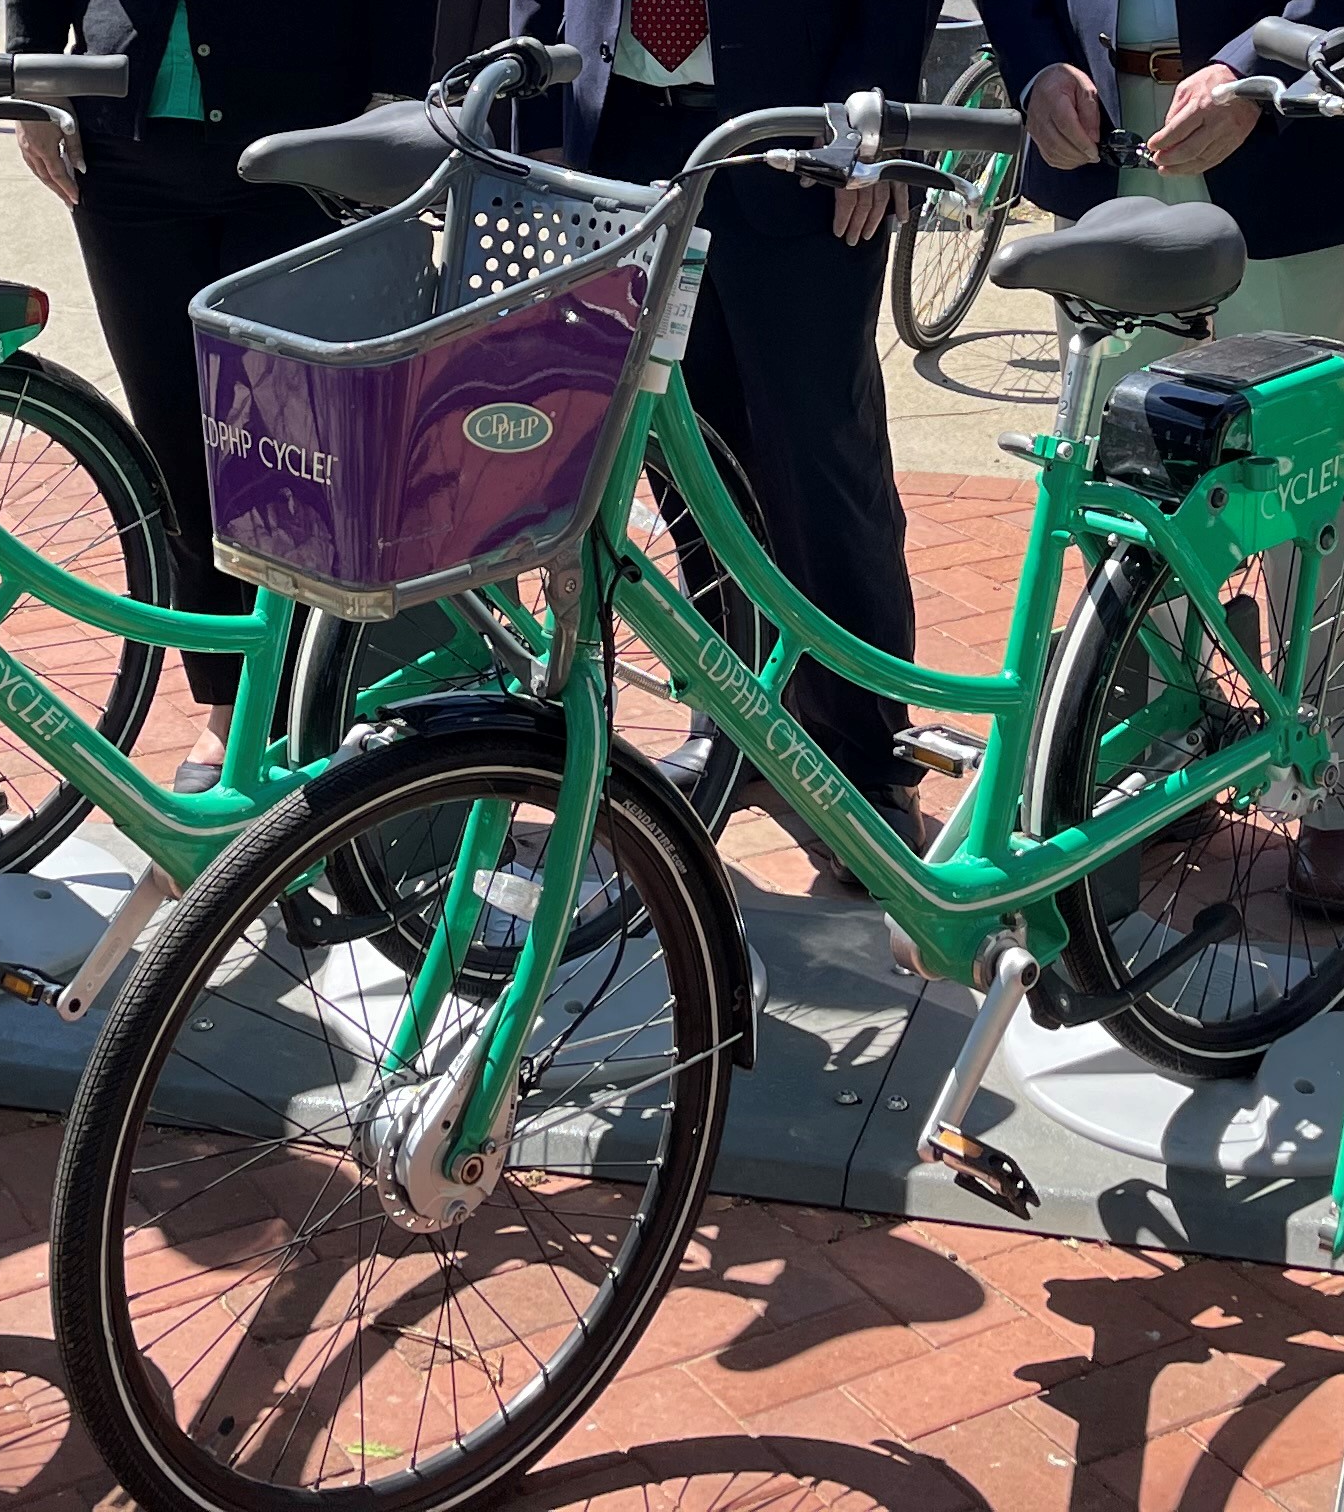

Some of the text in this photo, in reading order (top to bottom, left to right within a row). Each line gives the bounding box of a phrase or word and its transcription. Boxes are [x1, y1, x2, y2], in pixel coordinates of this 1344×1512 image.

[201, 413, 332, 486] CDPHP CYCLE!
[474, 411, 540, 445] CDPHP
[1259, 461, 1340, 521] CYCLE!
[697, 636, 842, 811] CDPHP CYCLE!
